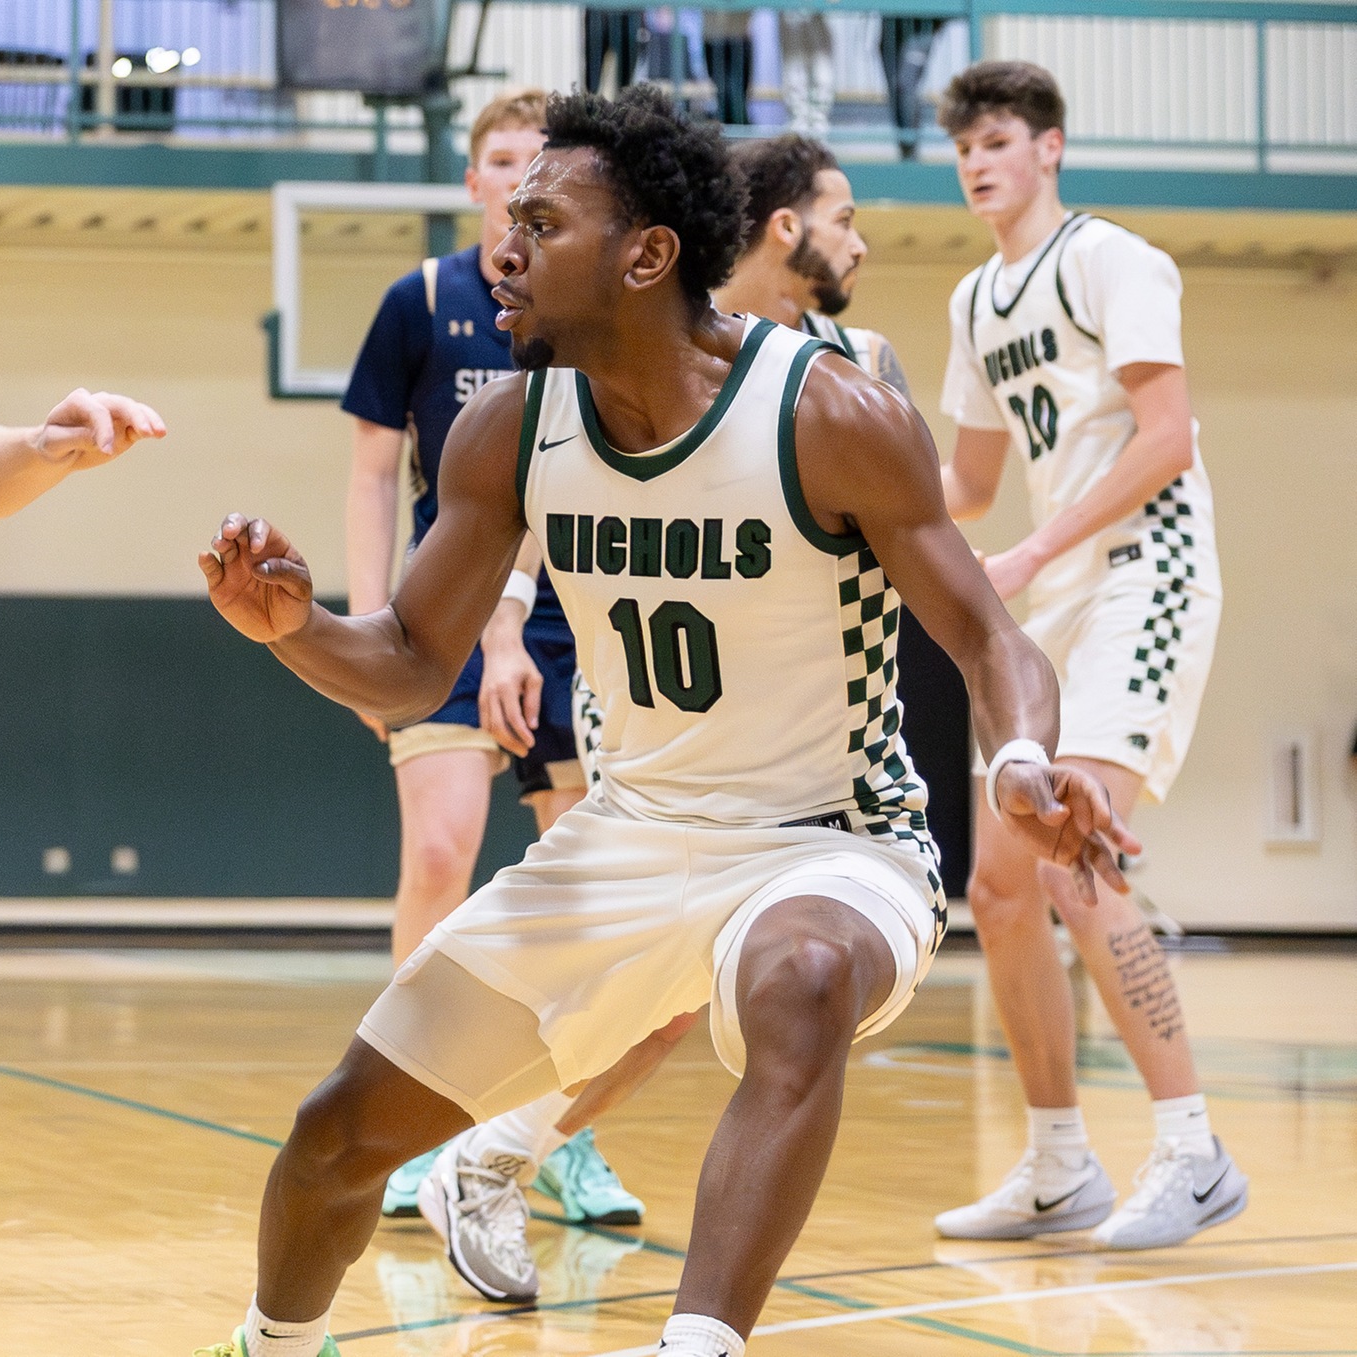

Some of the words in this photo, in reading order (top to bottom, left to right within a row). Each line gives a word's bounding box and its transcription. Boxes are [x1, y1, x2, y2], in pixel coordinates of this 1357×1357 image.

[984, 328, 1058, 387] NICHOLS
[1008, 384, 1059, 460] 20
[546, 513, 772, 580] NICHOLS
[607, 597, 723, 714] 10
